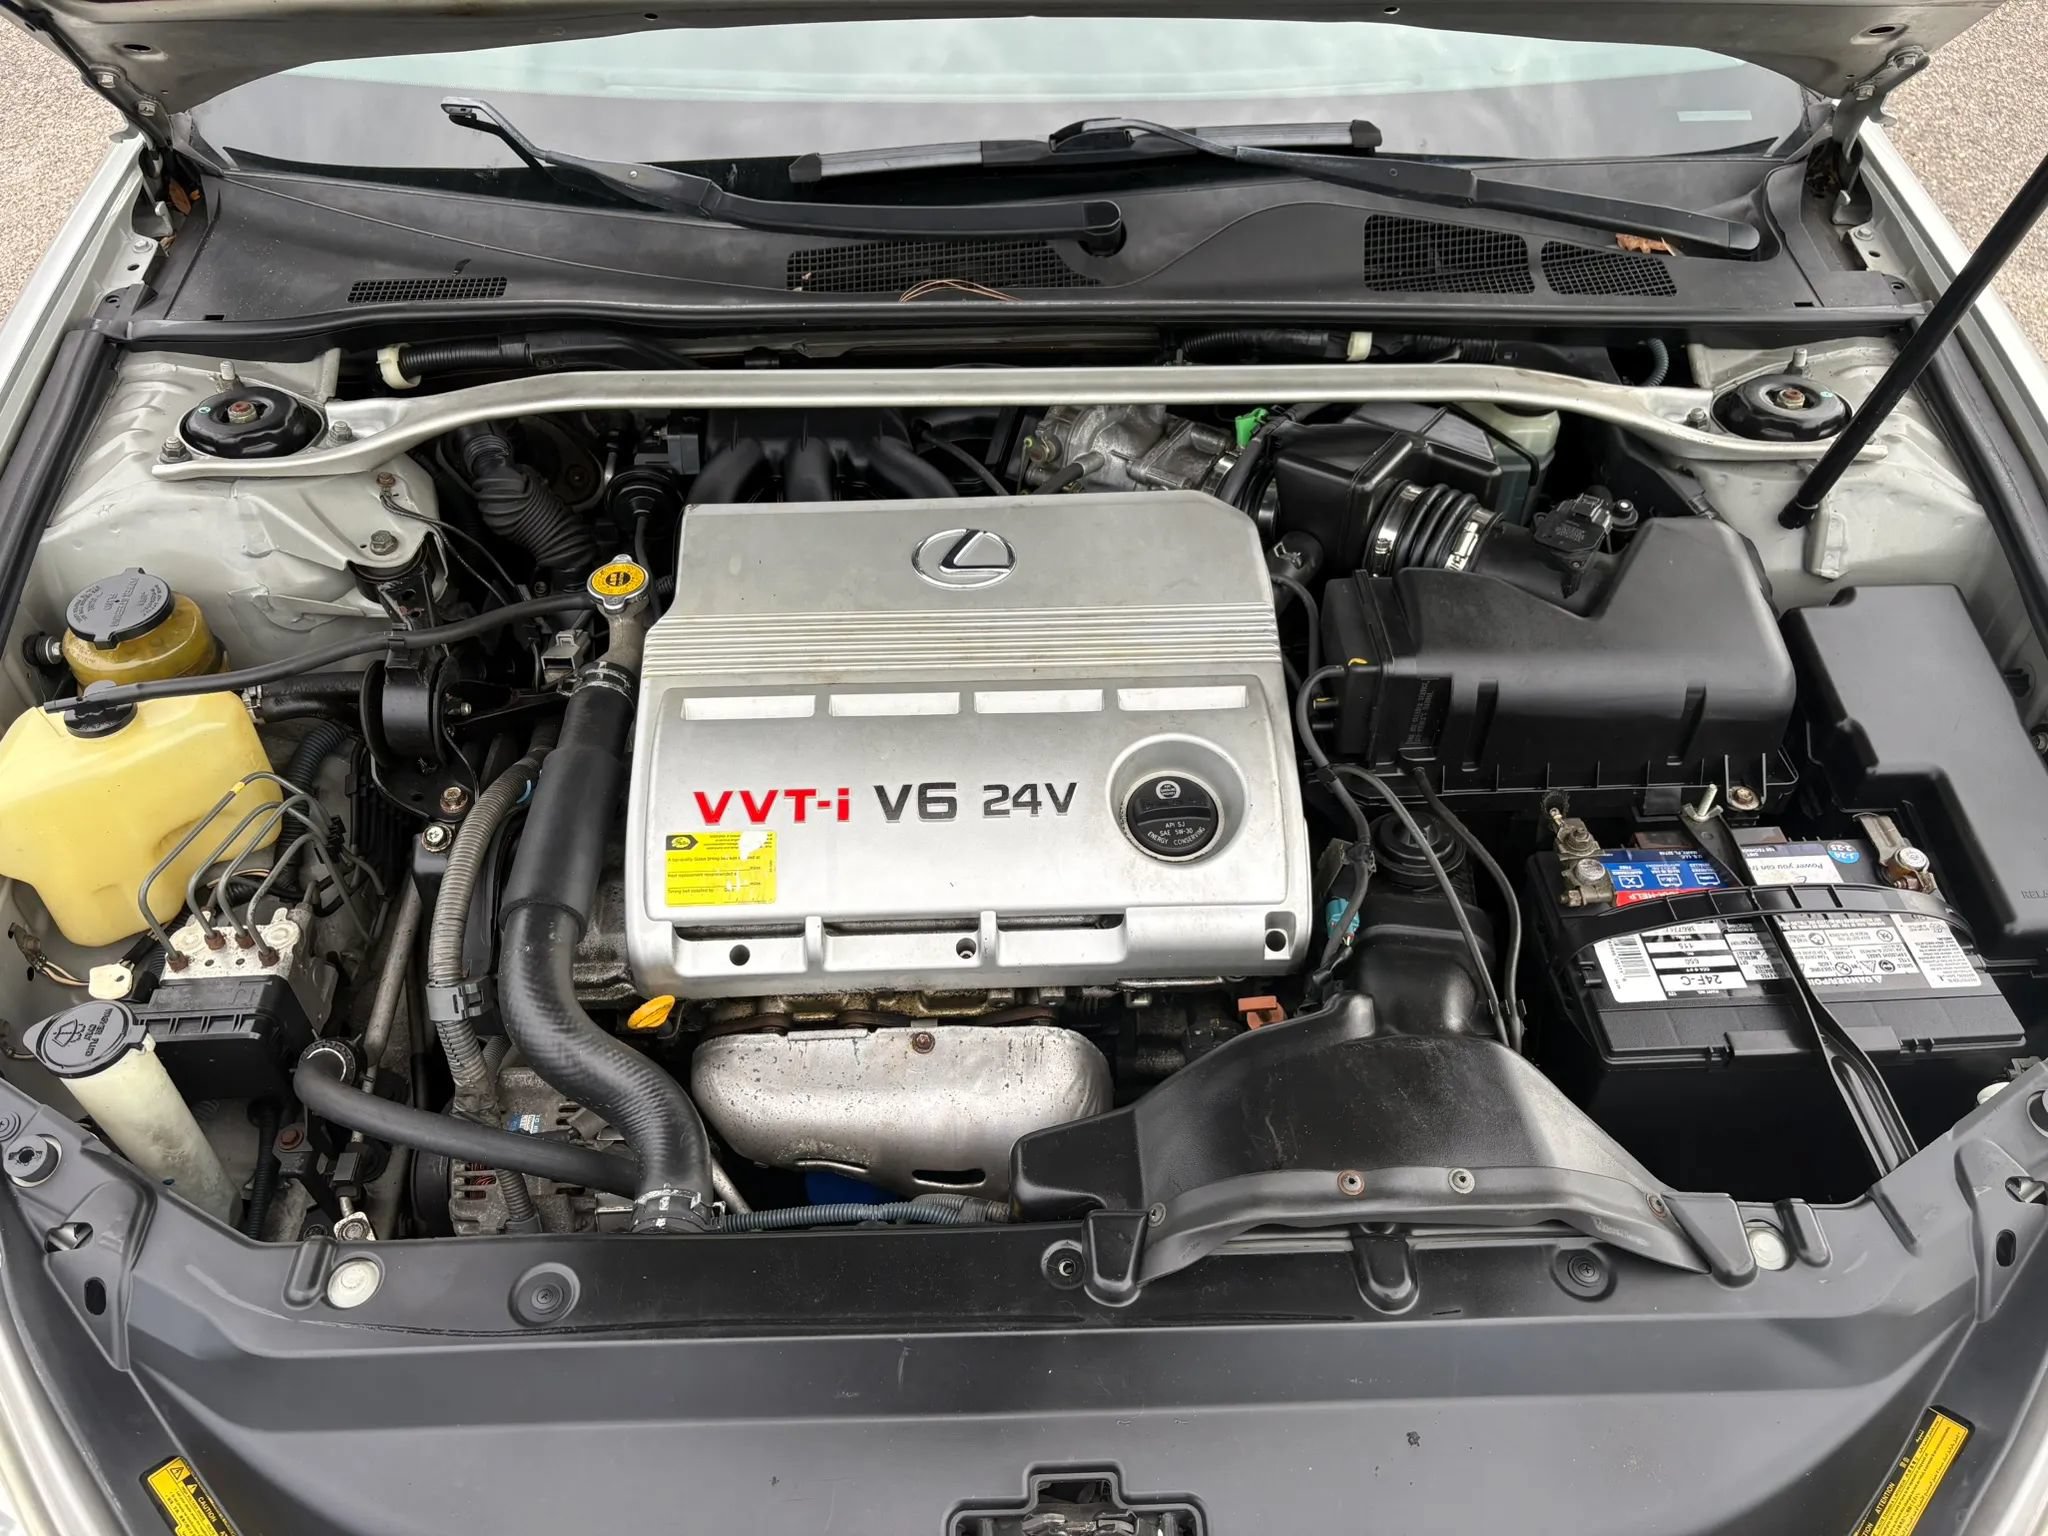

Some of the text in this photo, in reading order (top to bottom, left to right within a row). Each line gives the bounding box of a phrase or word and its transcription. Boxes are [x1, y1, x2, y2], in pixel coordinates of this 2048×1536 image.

[693, 782, 1078, 826] VVT-i V6 24V
[1147, 826, 1206, 846] ENERGY CONSERVING
[1777, 862, 1793, 870] you
[1680, 974, 1723, 986] 24F-C
[198, 1496, 217, 1522] CAUTION
[1875, 1482, 1896, 1515] ATTENTION
